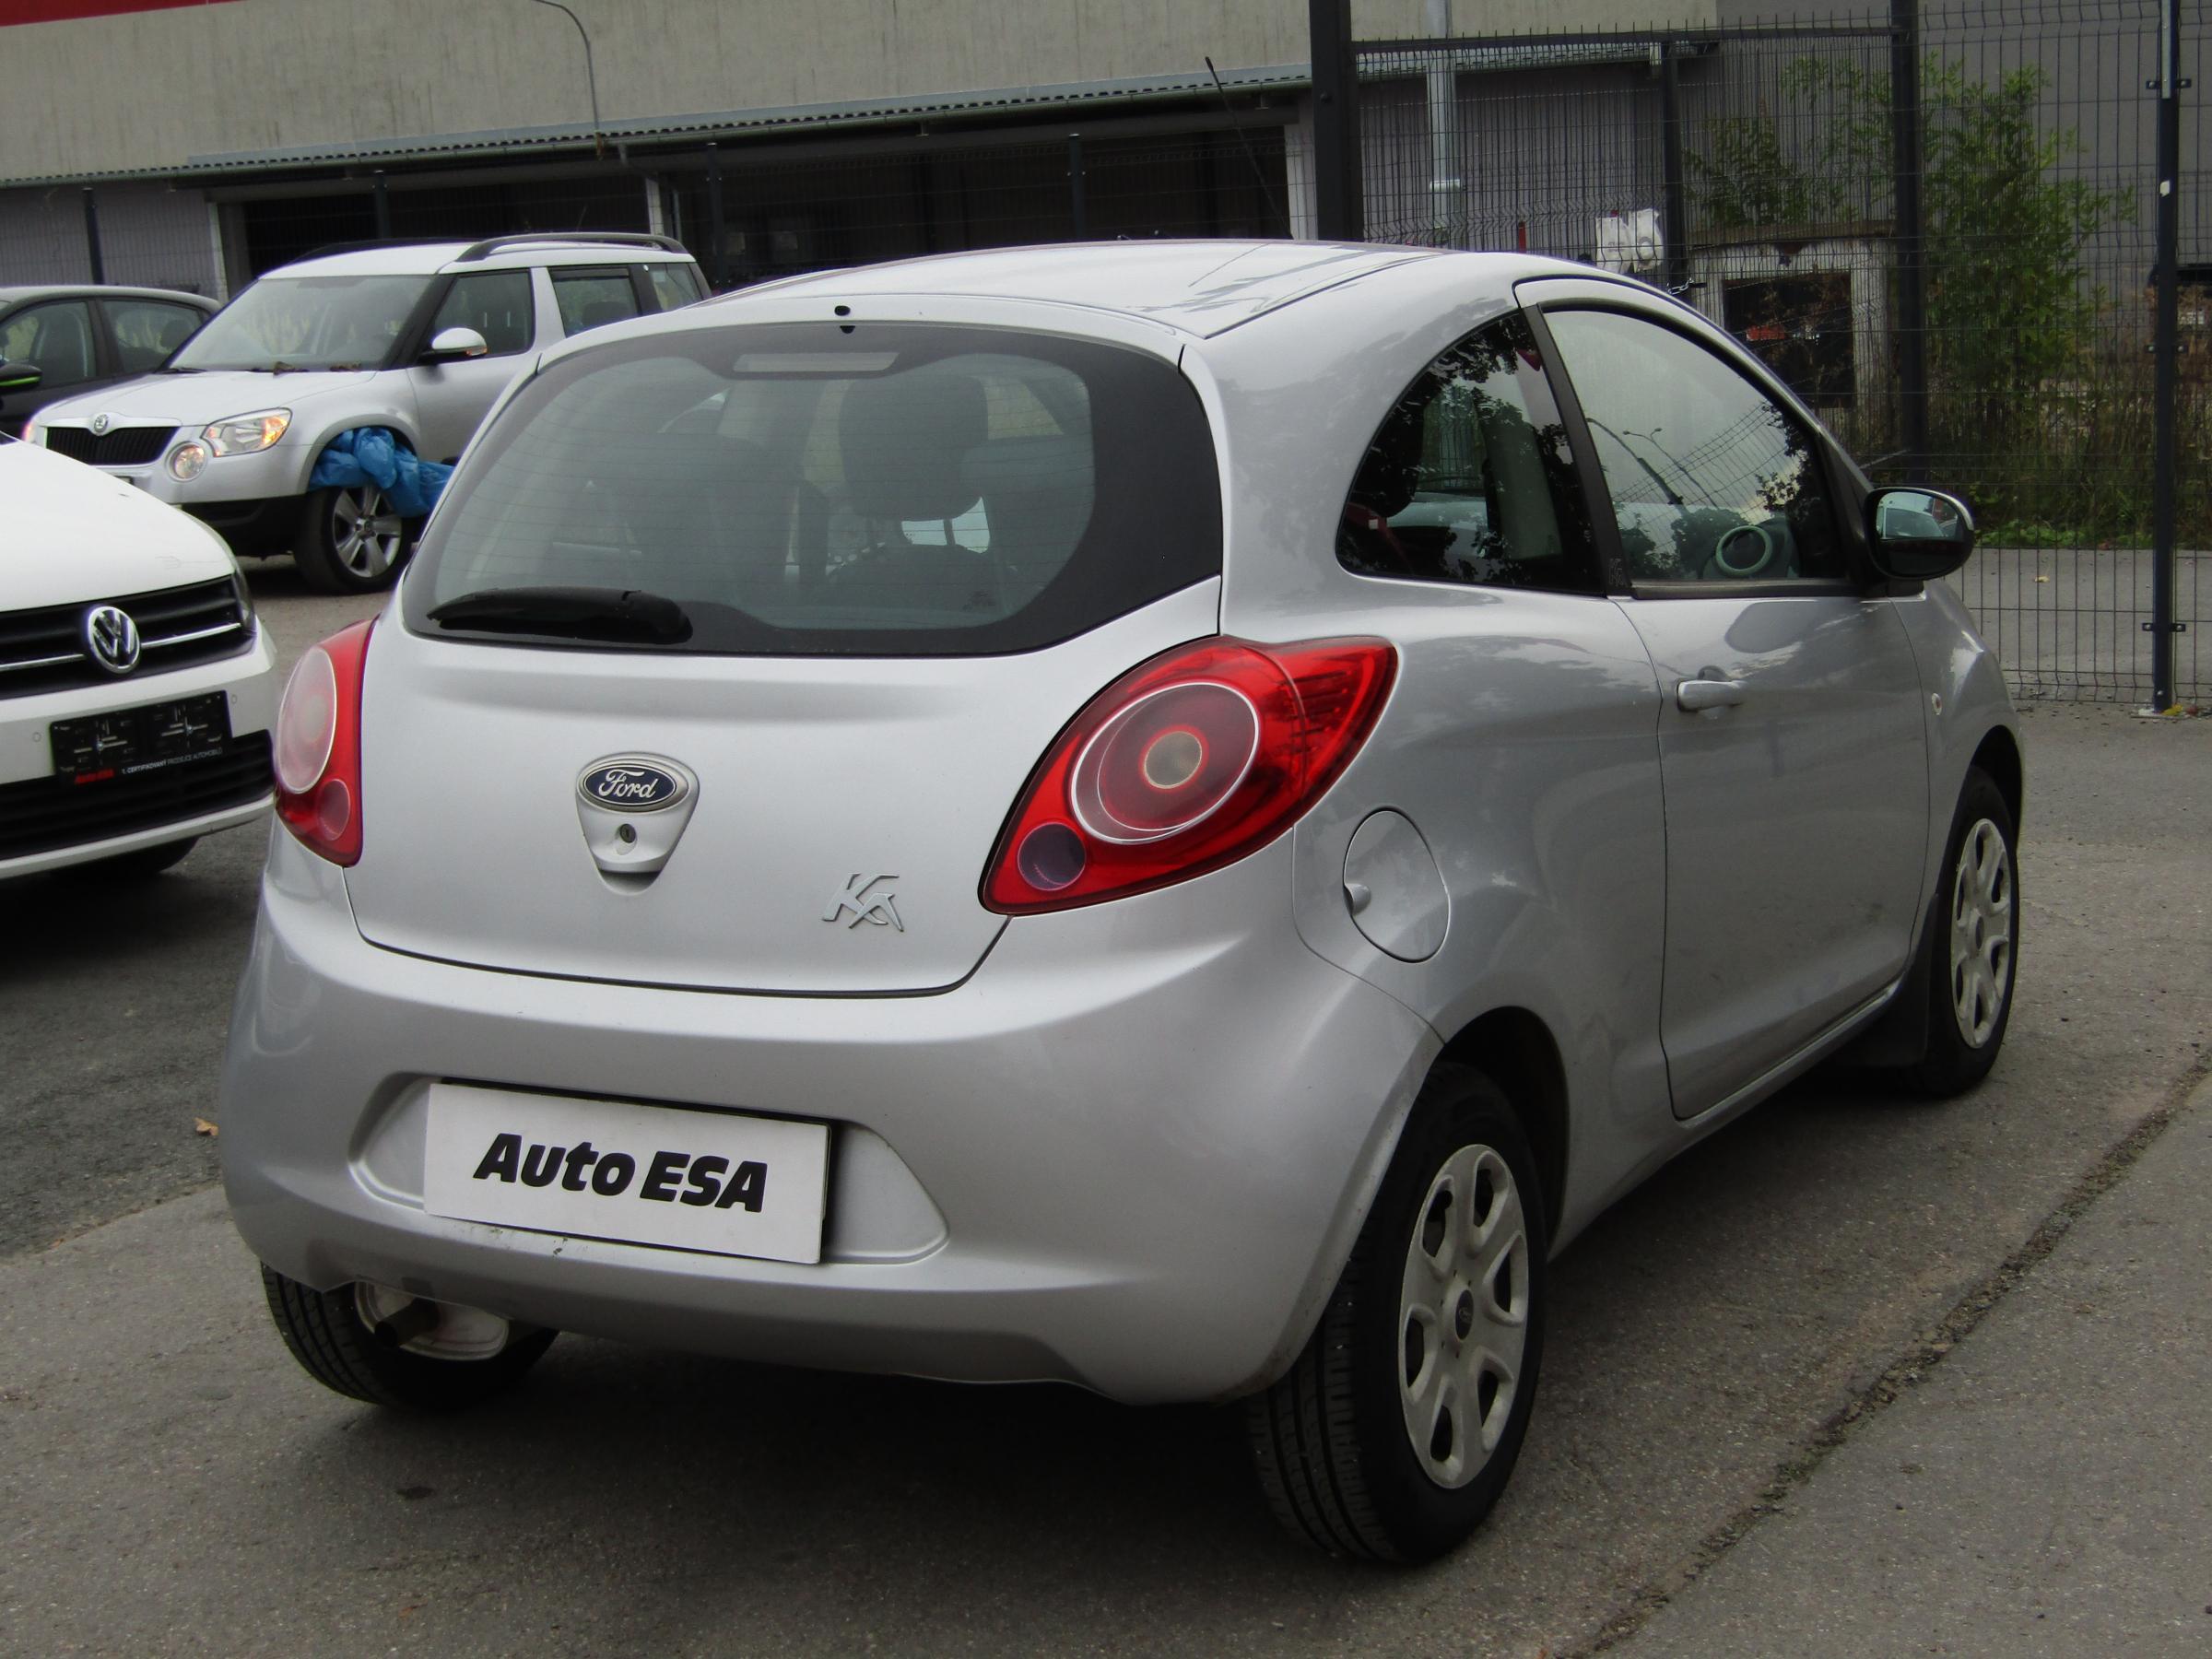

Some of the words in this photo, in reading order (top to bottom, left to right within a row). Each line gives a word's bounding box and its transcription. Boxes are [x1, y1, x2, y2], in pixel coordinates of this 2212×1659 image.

[597, 768, 659, 799] Ford
[472, 1132, 636, 1196] Auto
[640, 1150, 768, 1213] ESA
